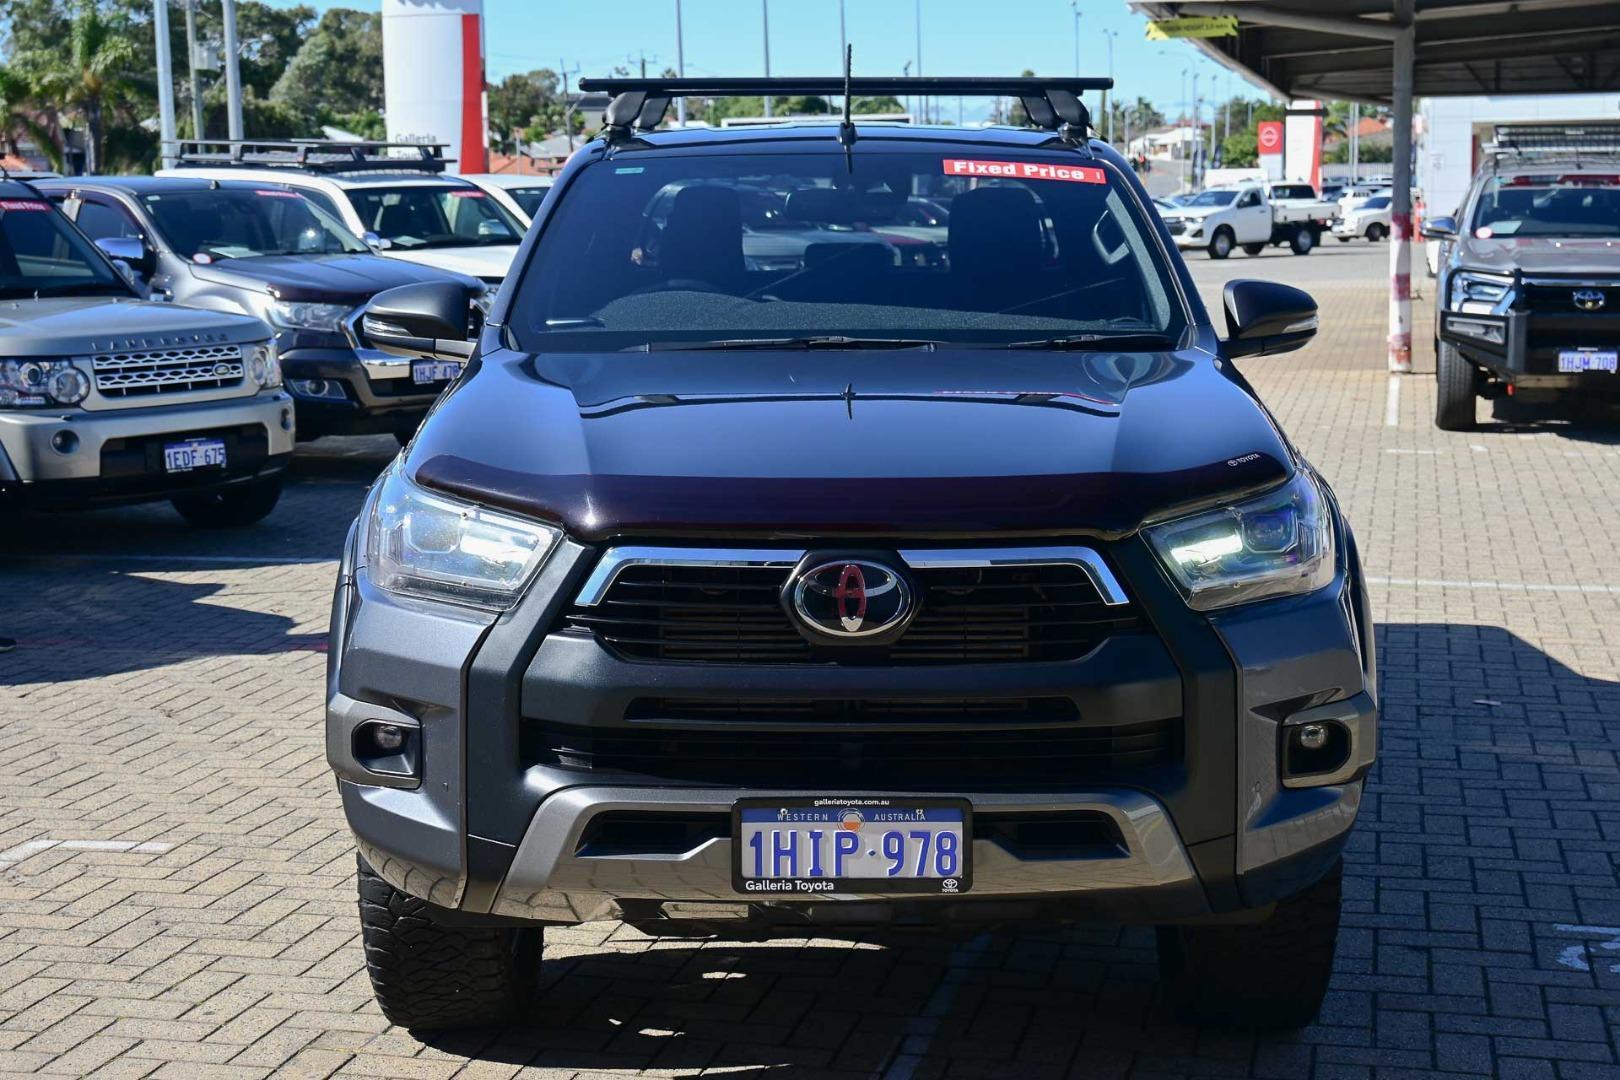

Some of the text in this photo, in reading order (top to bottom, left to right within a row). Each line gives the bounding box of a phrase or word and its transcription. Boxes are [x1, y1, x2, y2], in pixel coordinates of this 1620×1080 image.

[953, 161, 1016, 176] Fixed
[1023, 164, 1085, 180] Price
[814, 799, 890, 807] galleriatoyota.com.au
[777, 813, 926, 821] WESTERN AUSTRALIA
[745, 880, 834, 893] Galleria Toyota
